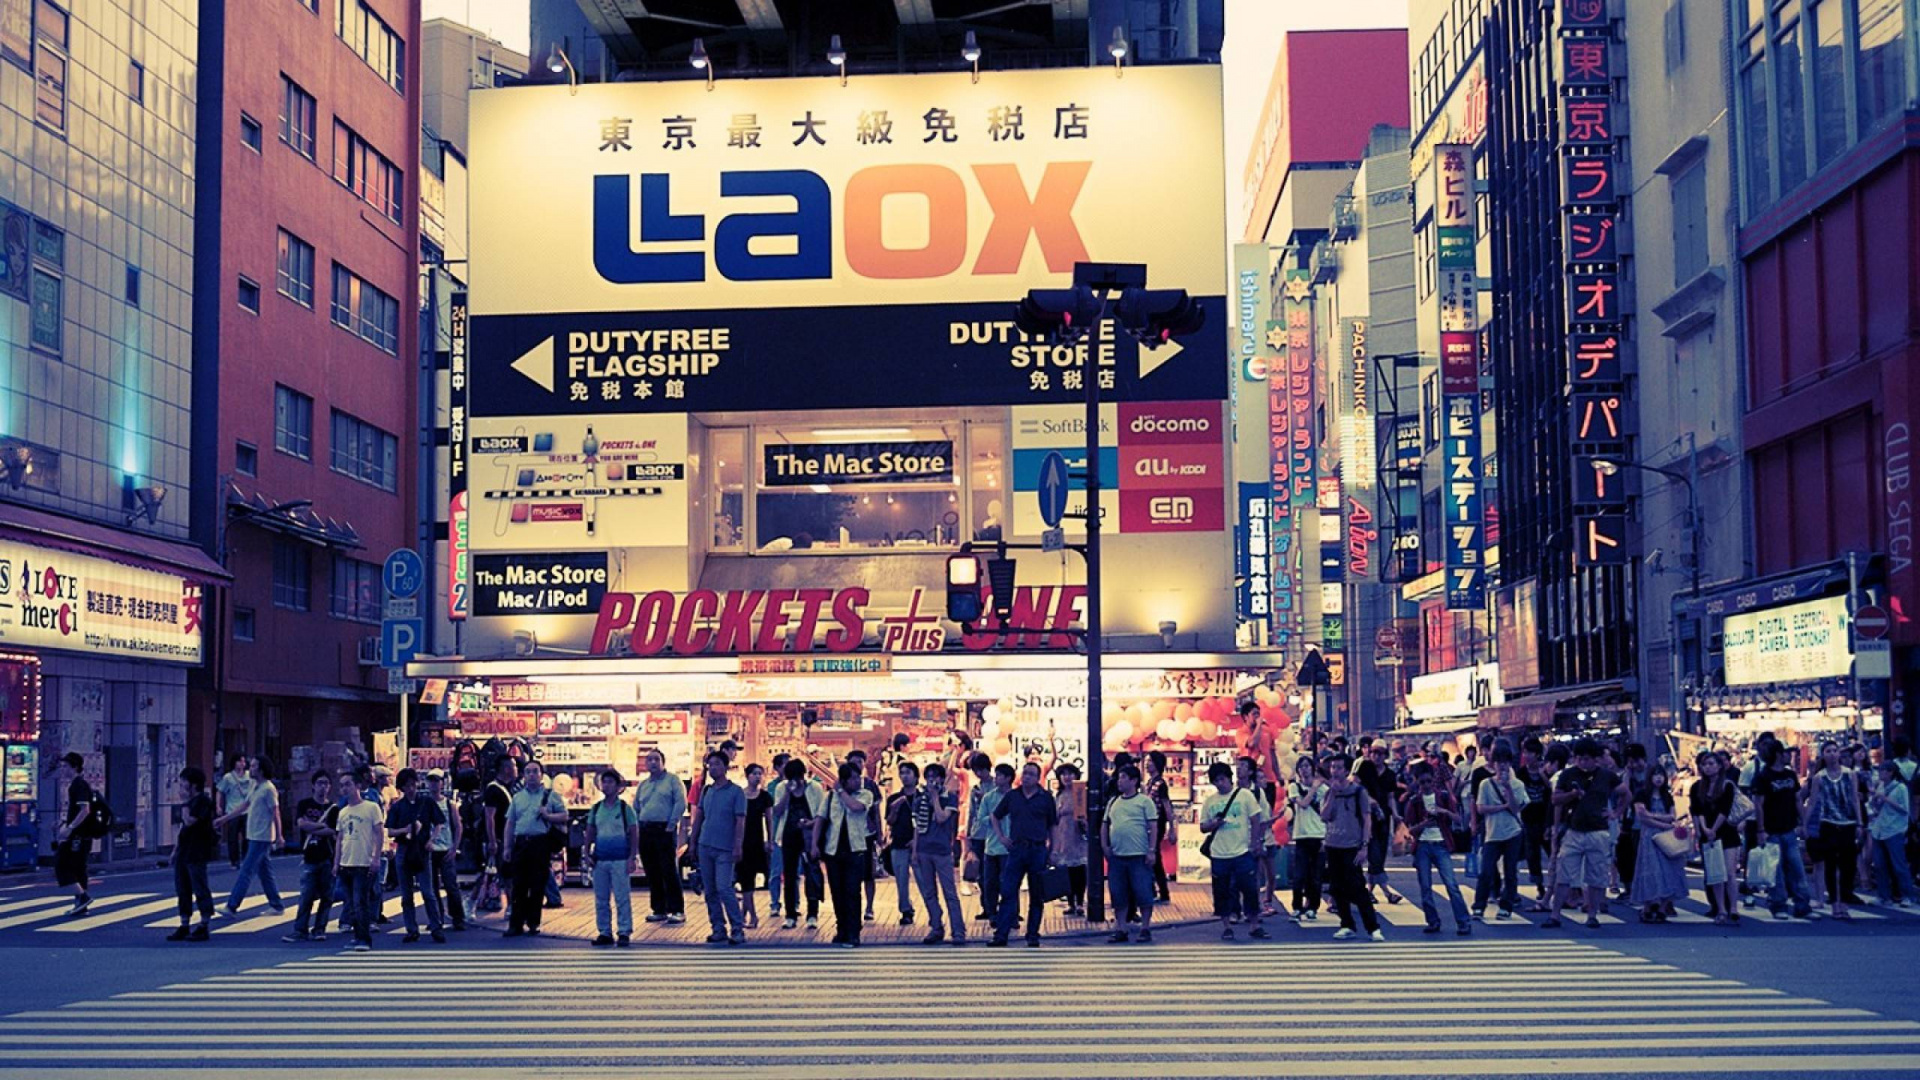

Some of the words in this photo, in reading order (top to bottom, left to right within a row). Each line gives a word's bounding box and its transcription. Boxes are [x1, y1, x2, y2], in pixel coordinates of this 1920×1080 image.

[598, 103, 1091, 152] 東京最大級免税店
[1444, 151, 1466, 220] 森ビル
[568, 328, 730, 353] DUTYFREE
[950, 319, 1115, 344] DUTE
[568, 353, 720, 378] FLAGSHIP
[1352, 321, 1367, 420] PACHINKO
[570, 379, 685, 401] 免税本館
[1030, 369, 1115, 390] 免税店
[1042, 417, 1110, 433] SoftBk
[1130, 415, 1210, 433] docomo
[600, 440, 633, 450] POCKETS
[642, 440, 657, 449] ONE
[773, 455, 819, 476] The
[824, 453, 873, 475] Mac
[878, 452, 945, 474] Store
[1135, 459, 1169, 475] au
[1885, 422, 1910, 493] CLUB
[1448, 397, 1476, 589] ホビーステーション
[1887, 501, 1912, 575] SEGA
[34, 566, 77, 600] LOVE
[392, 561, 407, 590] P
[475, 571, 503, 585] The
[505, 565, 547, 585] Mac
[551, 564, 606, 584] Store
[497, 591, 534, 608] Mac
[547, 588, 588, 607] iPod
[1736, 592, 1757, 608] CASIO
[1773, 584, 1796, 601] CASIO
[1706, 600, 1724, 614] CASIO
[590, 586, 871, 655] POCKETS
[1758, 617, 1788, 636] DIGITAL
[392, 624, 415, 663] P
[1014, 693, 1086, 709] Share!
[539, 716, 557, 731] 2F
[557, 712, 601, 724] Mac
